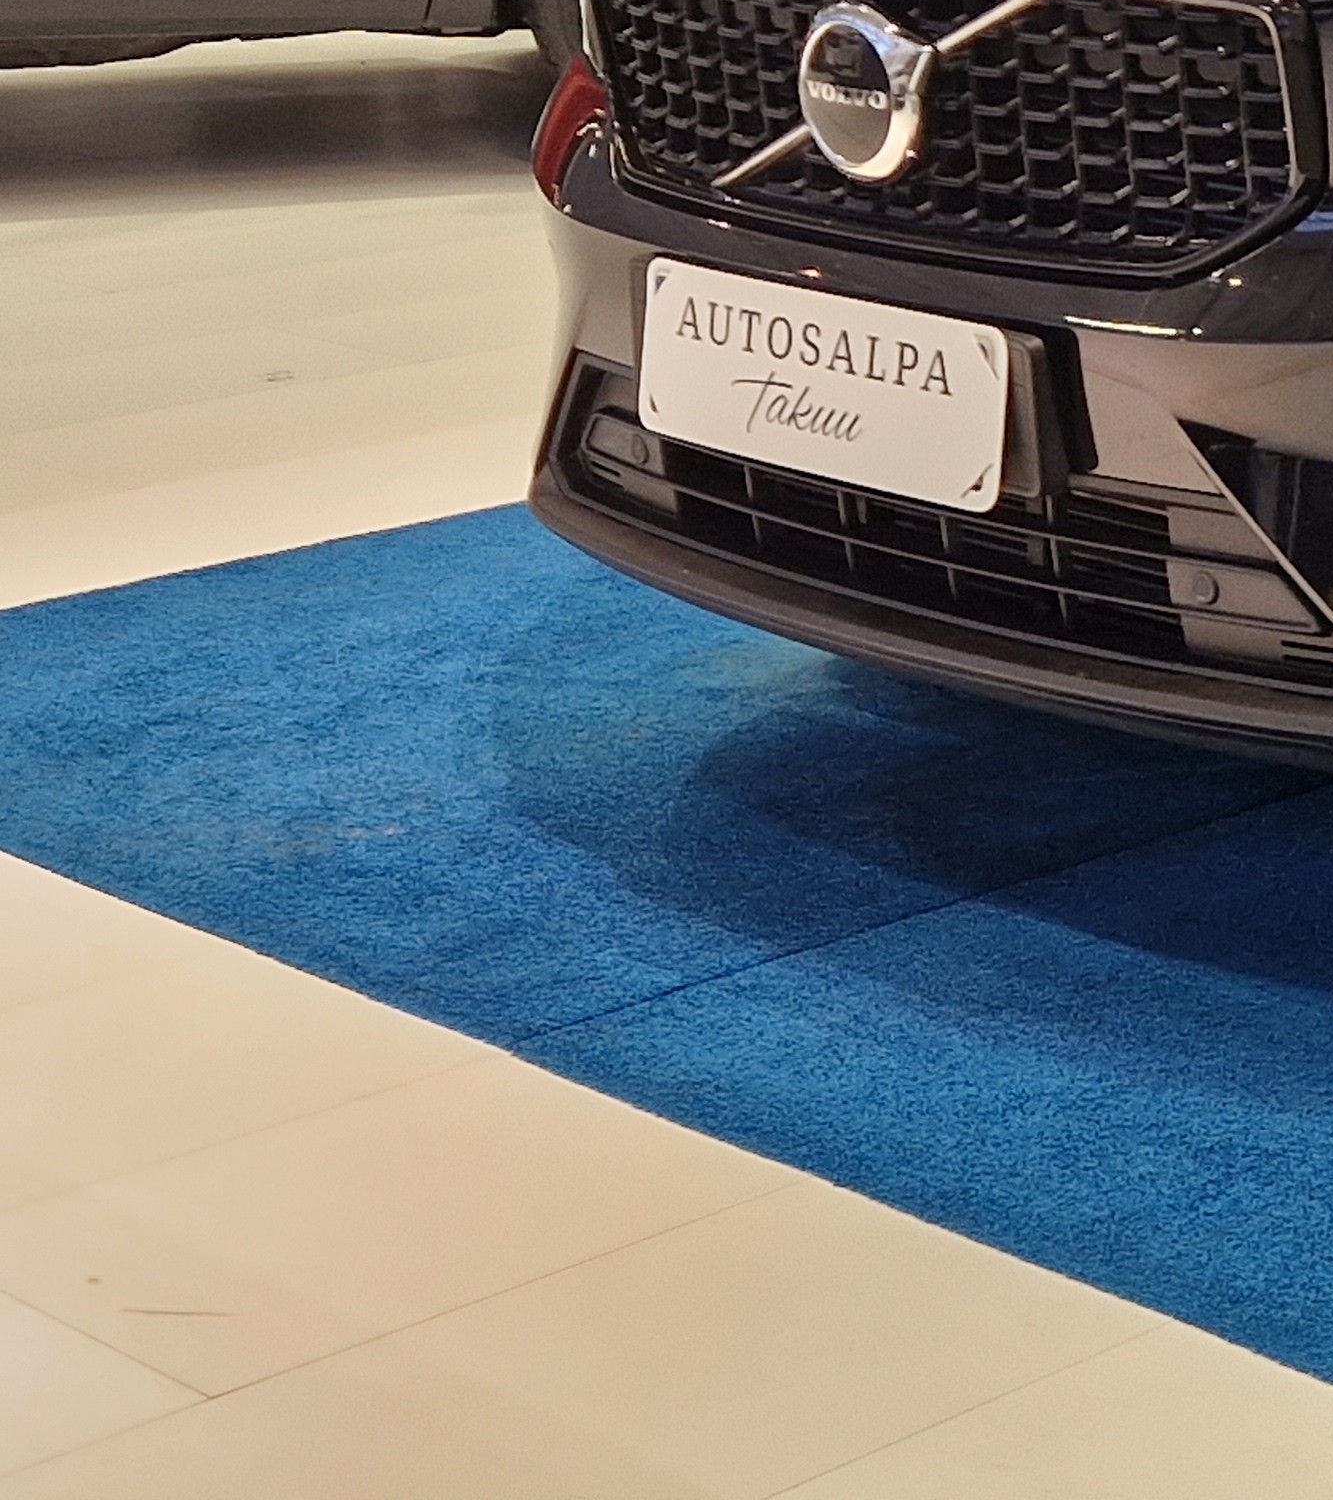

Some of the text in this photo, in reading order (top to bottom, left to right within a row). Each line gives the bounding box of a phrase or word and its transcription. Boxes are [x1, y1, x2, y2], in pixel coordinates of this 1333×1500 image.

[805, 80, 888, 110] VOLVO
[676, 296, 953, 397] AUTOSALPA
[731, 371, 863, 443] Takuu
